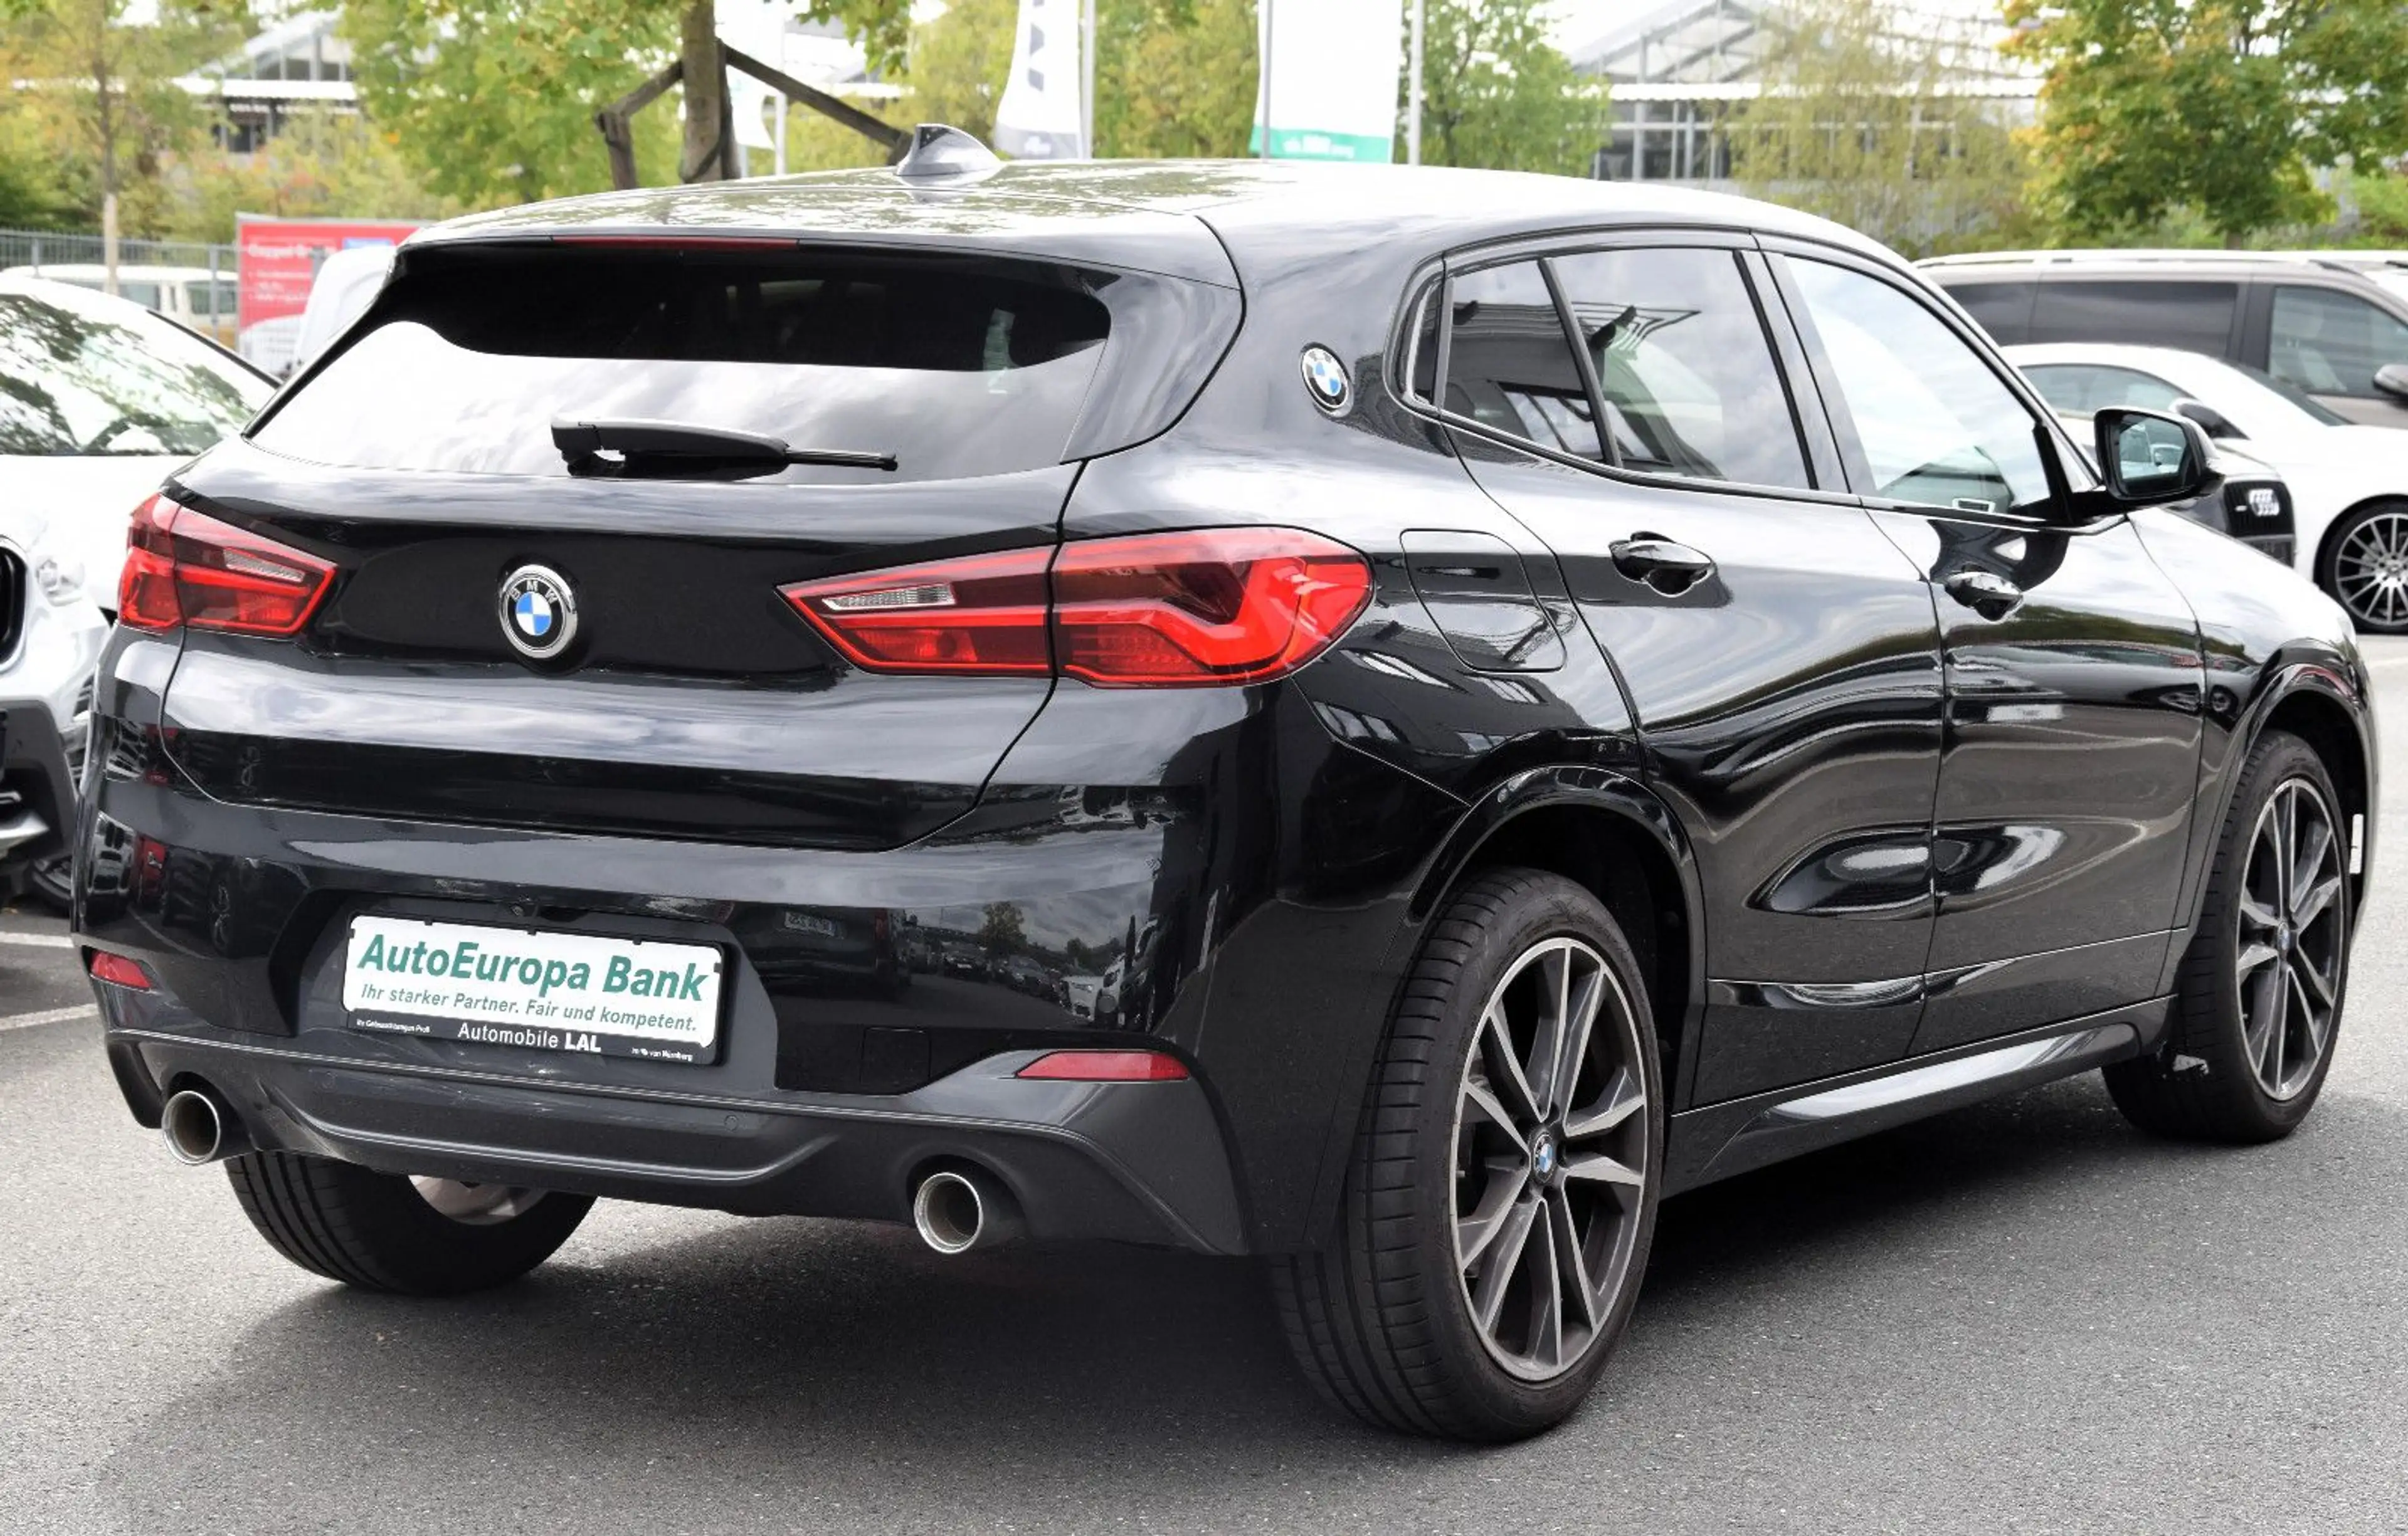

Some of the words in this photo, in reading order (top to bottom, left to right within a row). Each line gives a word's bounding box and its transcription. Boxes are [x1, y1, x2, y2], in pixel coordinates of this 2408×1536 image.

[356, 934, 591, 998] AutoEuropa
[602, 955, 709, 1001] Bank
[361, 983, 384, 1000] Ihr
[389, 988, 449, 1006] starker
[453, 992, 519, 1013] Partner.
[525, 999, 559, 1016] Fair
[563, 1006, 596, 1021] und
[599, 1006, 697, 1031] kompetent.
[457, 1022, 559, 1048] Automobile
[564, 1031, 602, 1053] LAL
